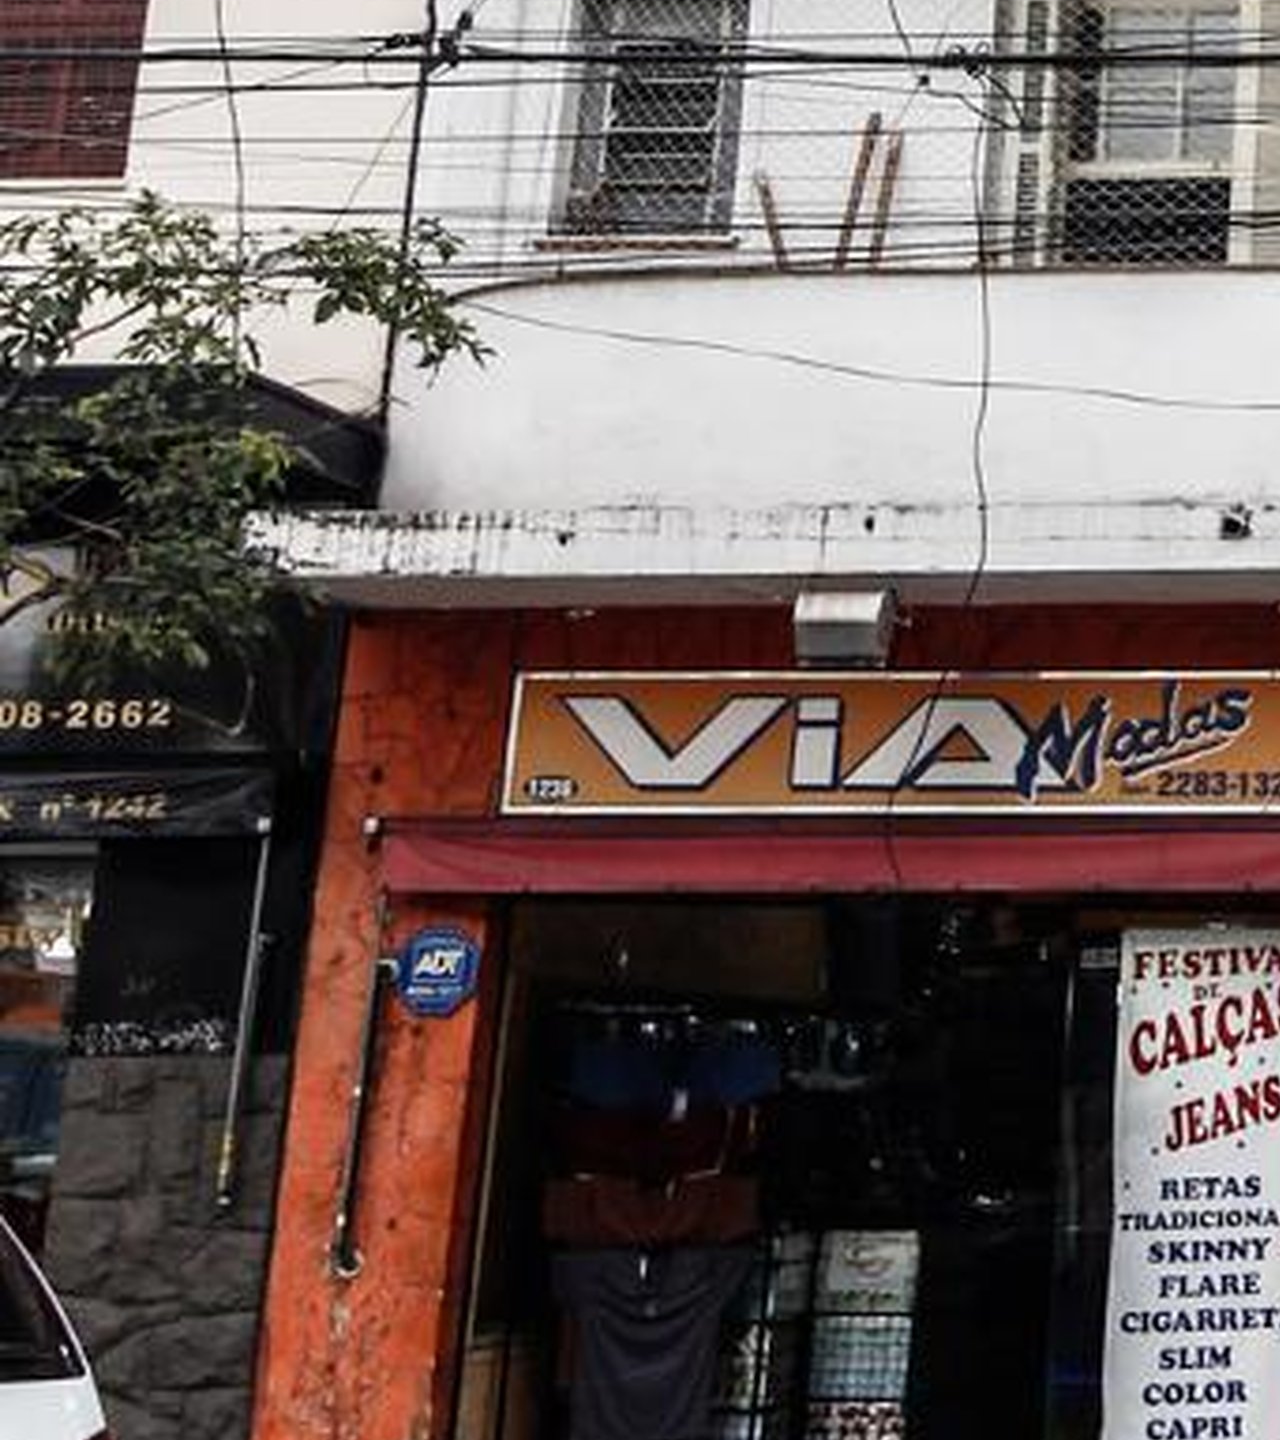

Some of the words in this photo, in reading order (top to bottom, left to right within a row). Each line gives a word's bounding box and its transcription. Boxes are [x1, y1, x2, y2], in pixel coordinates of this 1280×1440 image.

[1015, 678, 1254, 804] Modas
[413, 949, 465, 976] ADT
[1160, 1176, 1261, 1200] RETAS
[1147, 1237, 1272, 1264] SKINNY
[1158, 1273, 1262, 1299] FLARE
[1159, 1346, 1232, 1370] SLIM
[1142, 1380, 1247, 1407] COLOR
[1146, 1416, 1243, 1440] CAPRI
